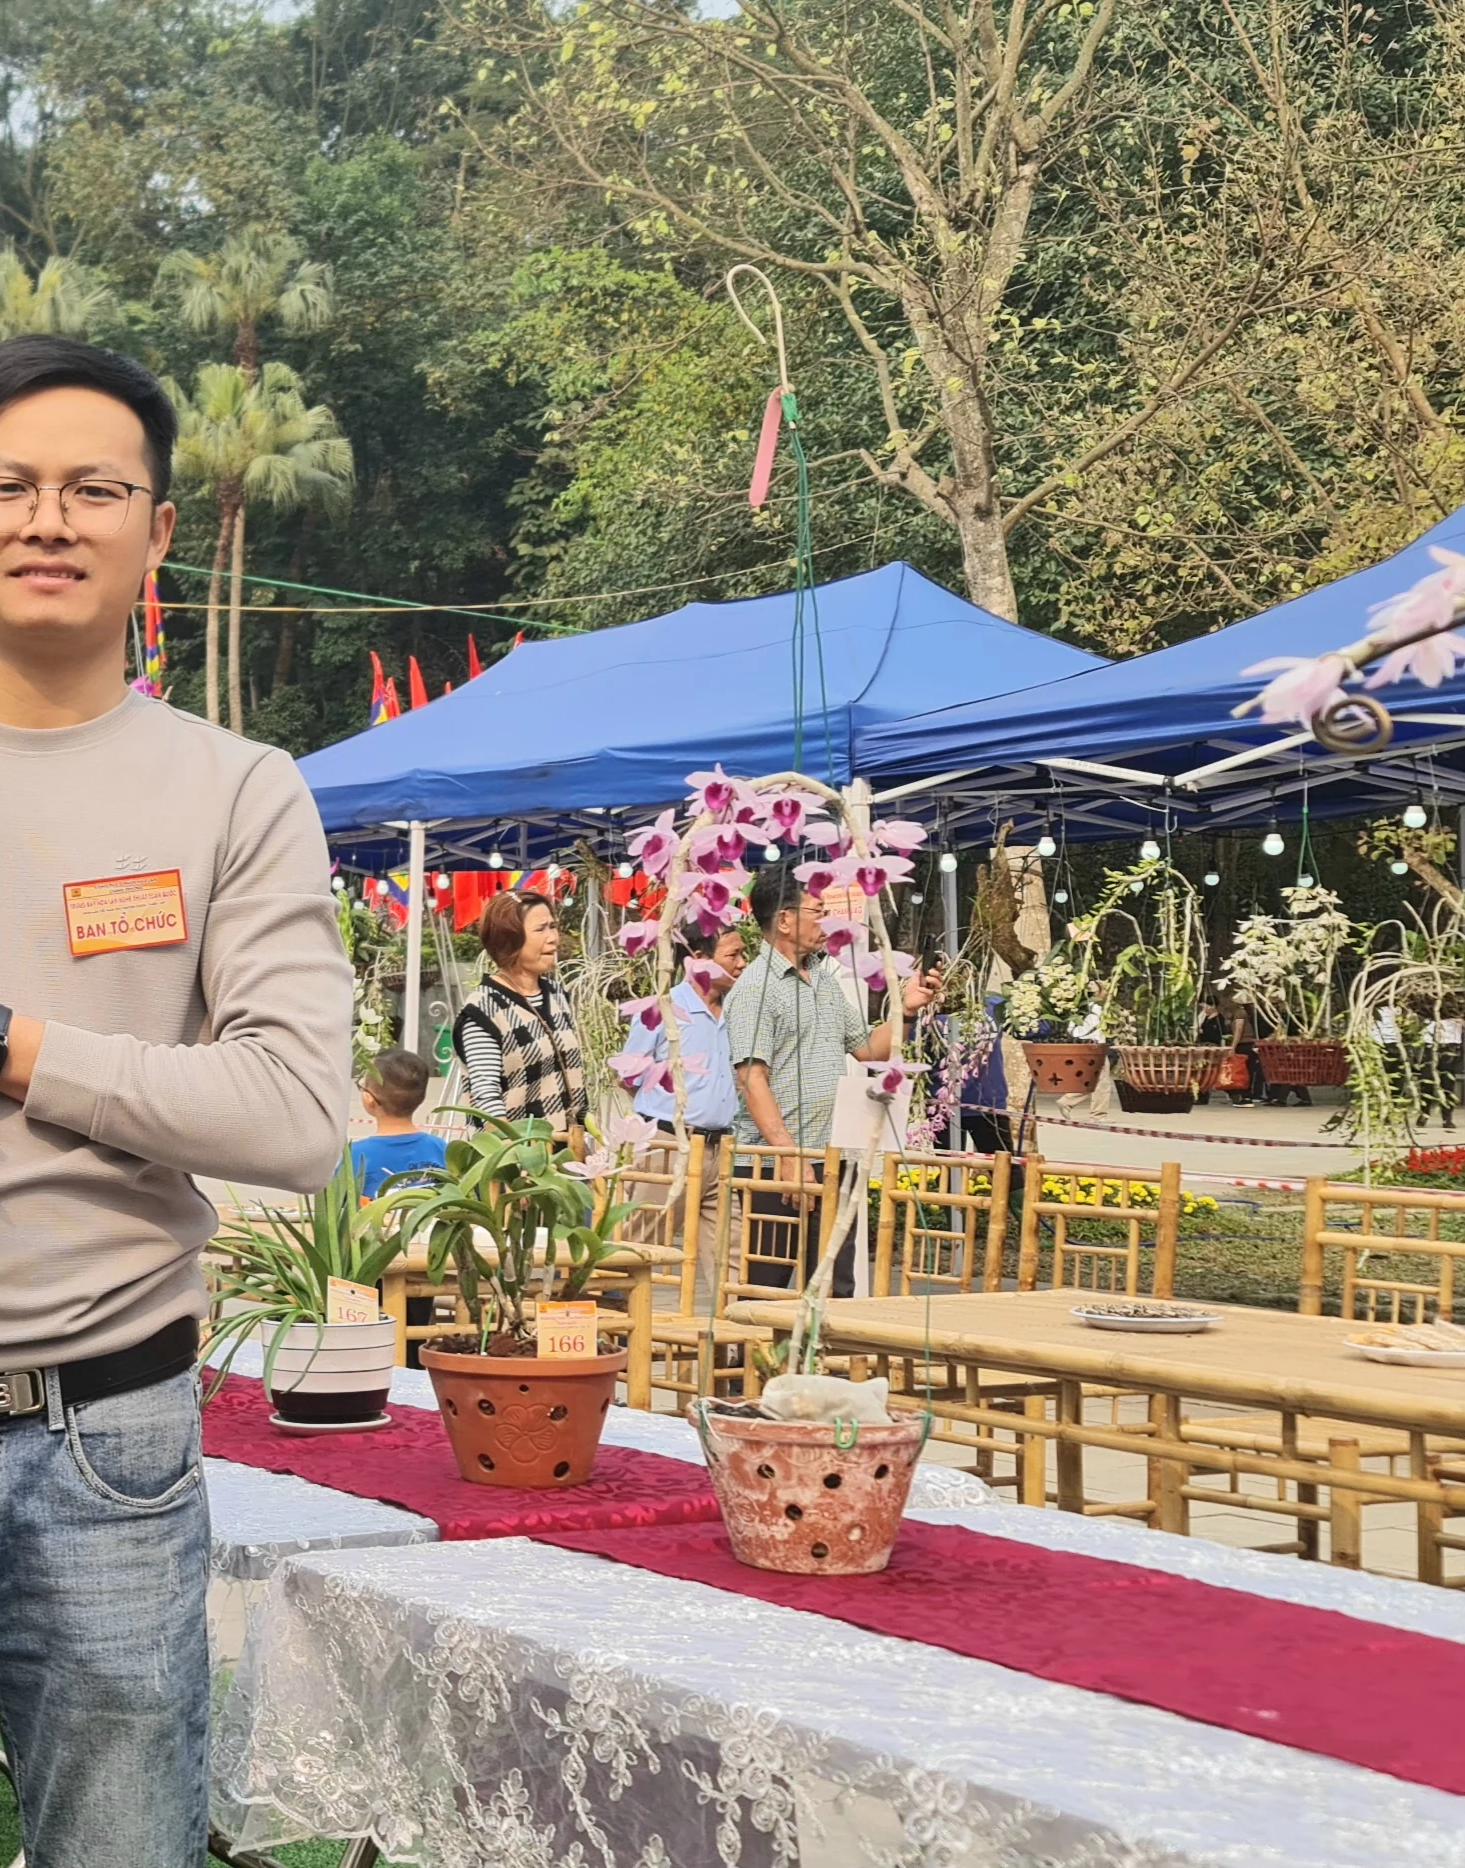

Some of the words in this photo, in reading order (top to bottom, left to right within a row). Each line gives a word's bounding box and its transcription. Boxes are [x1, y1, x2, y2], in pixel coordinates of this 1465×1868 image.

[76, 922, 107, 940] BAN
[111, 911, 130, 935] TỔ
[133, 910, 178, 932] CHỨC
[337, 1305, 368, 1323] 167
[547, 1334, 585, 1353] 166
